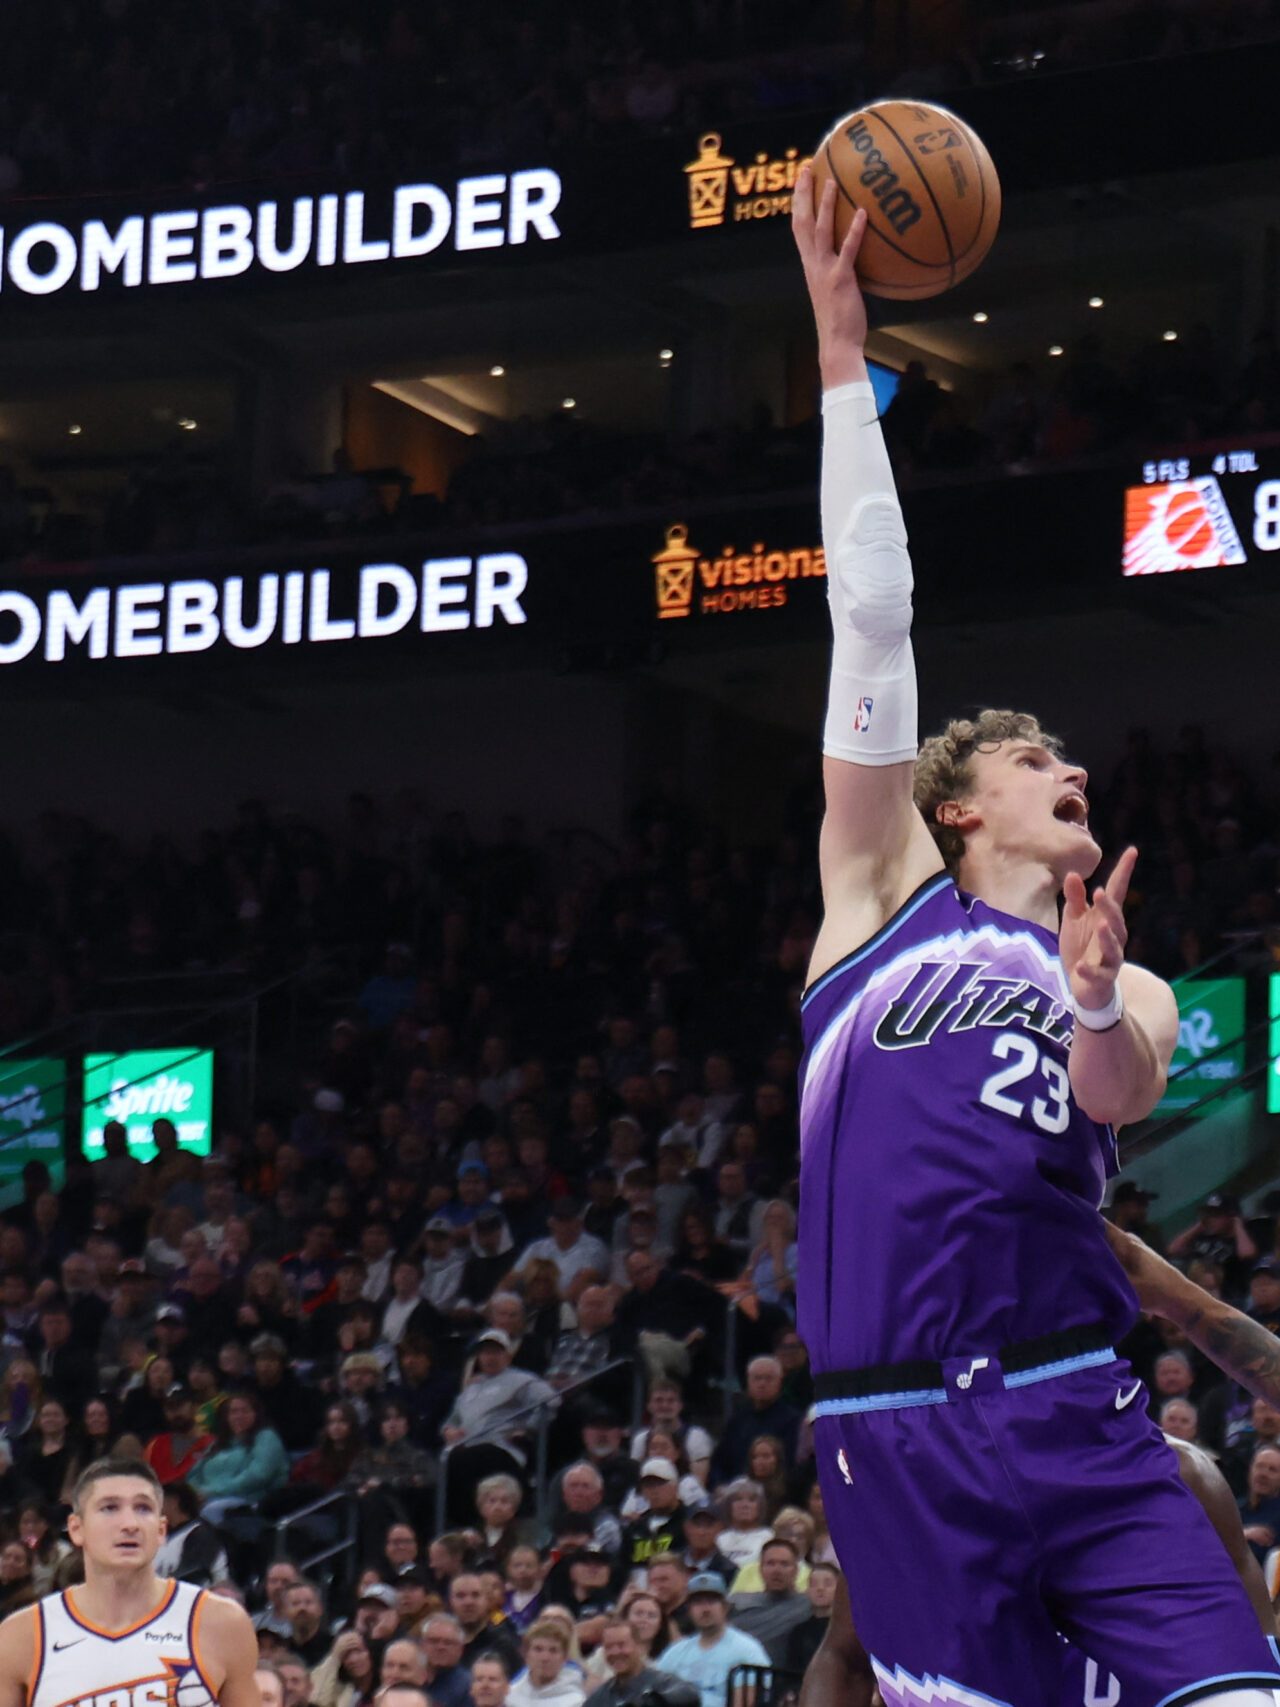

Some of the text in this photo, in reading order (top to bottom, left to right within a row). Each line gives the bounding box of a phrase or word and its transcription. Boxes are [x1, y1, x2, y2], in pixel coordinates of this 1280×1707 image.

[845, 119, 922, 235] Wilson
[0, 169, 563, 294] OMEBUILDER
[1143, 458, 1190, 483] 5 FLS
[1212, 454, 1226, 474] 4
[1201, 485, 1240, 558] BONUS
[702, 585, 788, 613] HOMES
[104, 1075, 194, 1124] Sprite
[980, 1033, 1071, 1134] 23
[145, 1632, 183, 1643] PayPal
